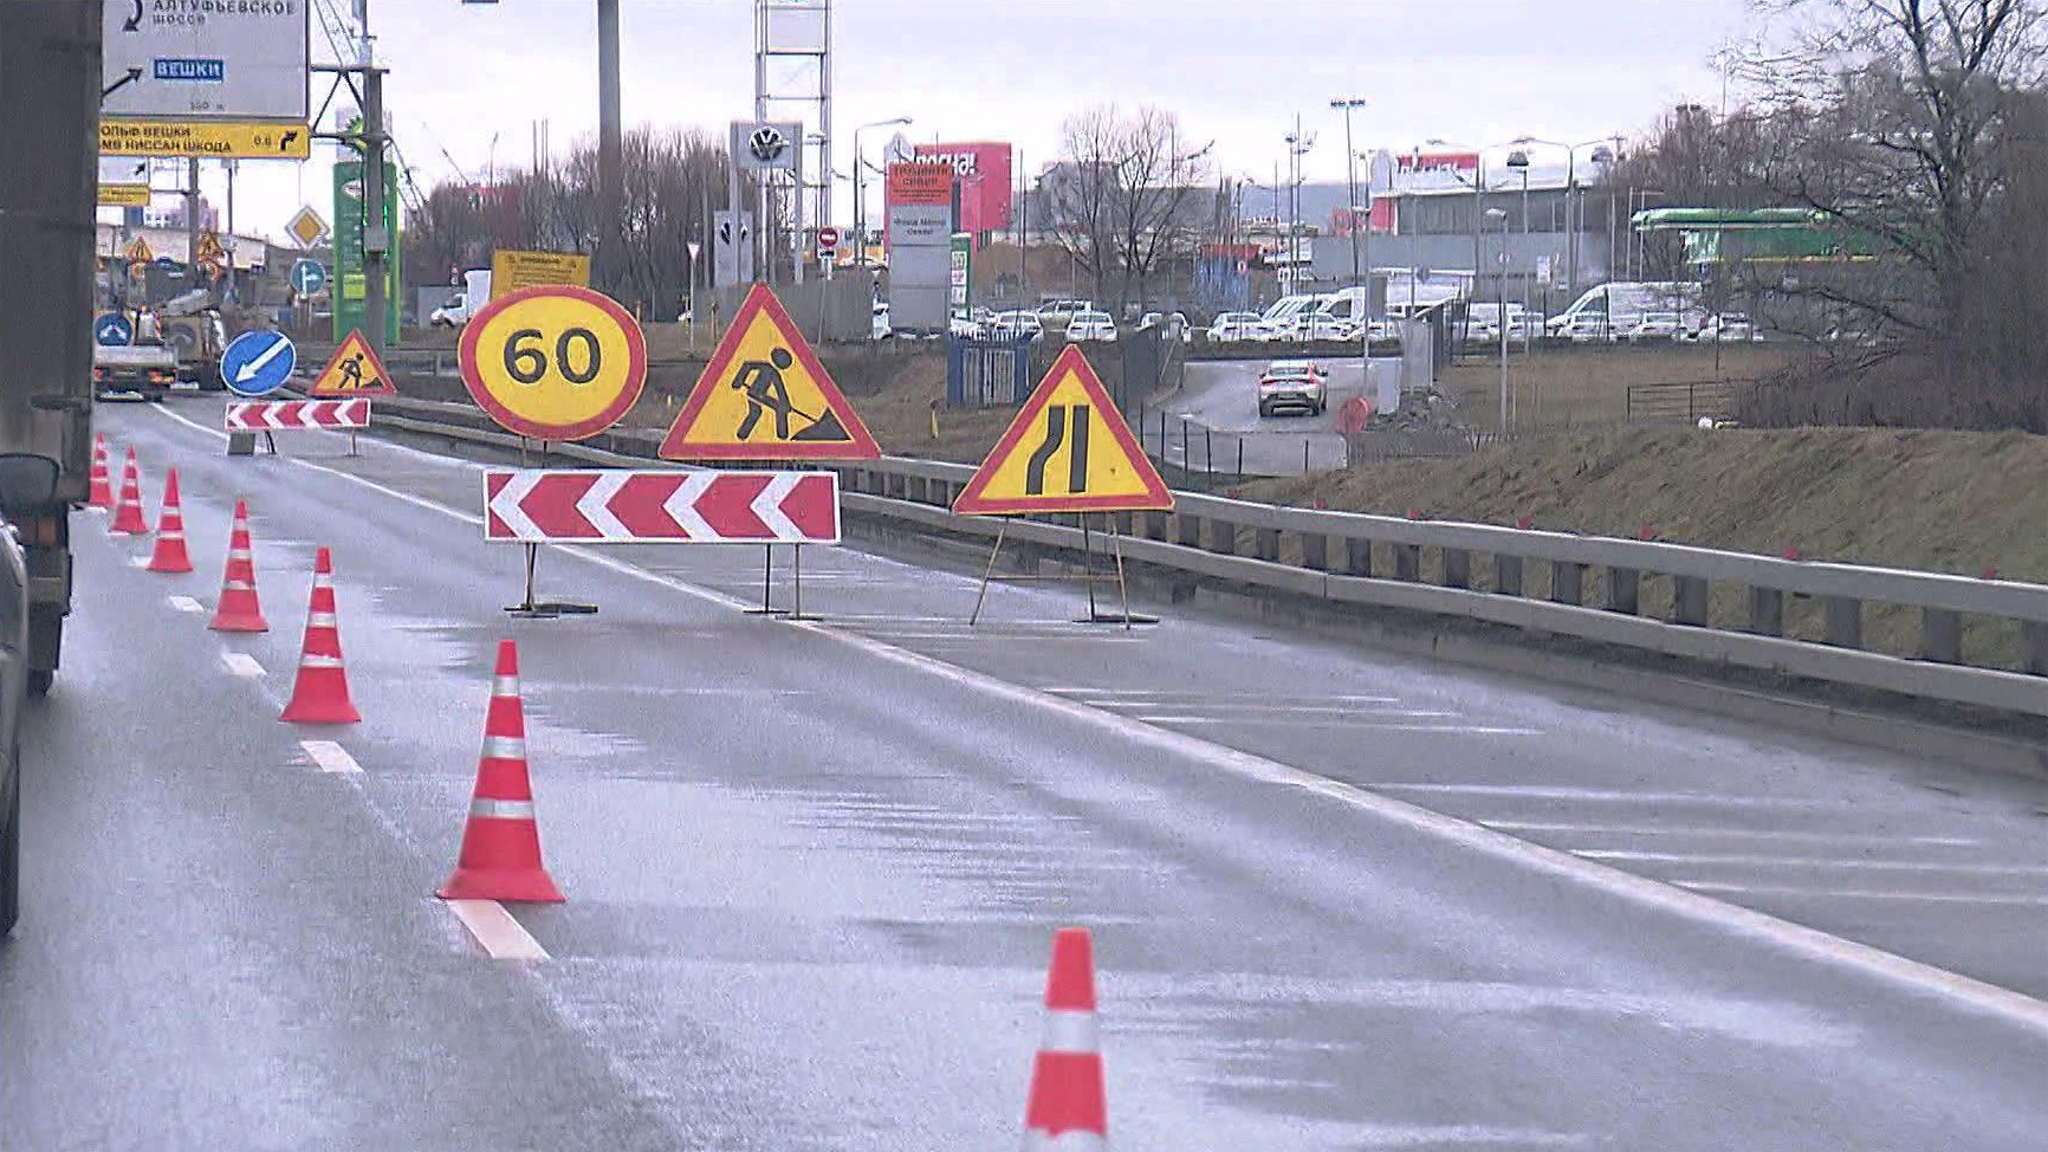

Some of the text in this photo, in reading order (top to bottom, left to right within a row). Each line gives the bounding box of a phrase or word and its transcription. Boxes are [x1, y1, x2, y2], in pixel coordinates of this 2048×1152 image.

[153, 0, 297, 15] АЛТУФЬЕВСКОЕ
[157, 61, 221, 77] ВЕШКИ
[101, 125, 140, 137] ОЛЬФ
[101, 139, 231, 153] МВ НИССАН ШКОДА
[504, 327, 601, 385] 60
